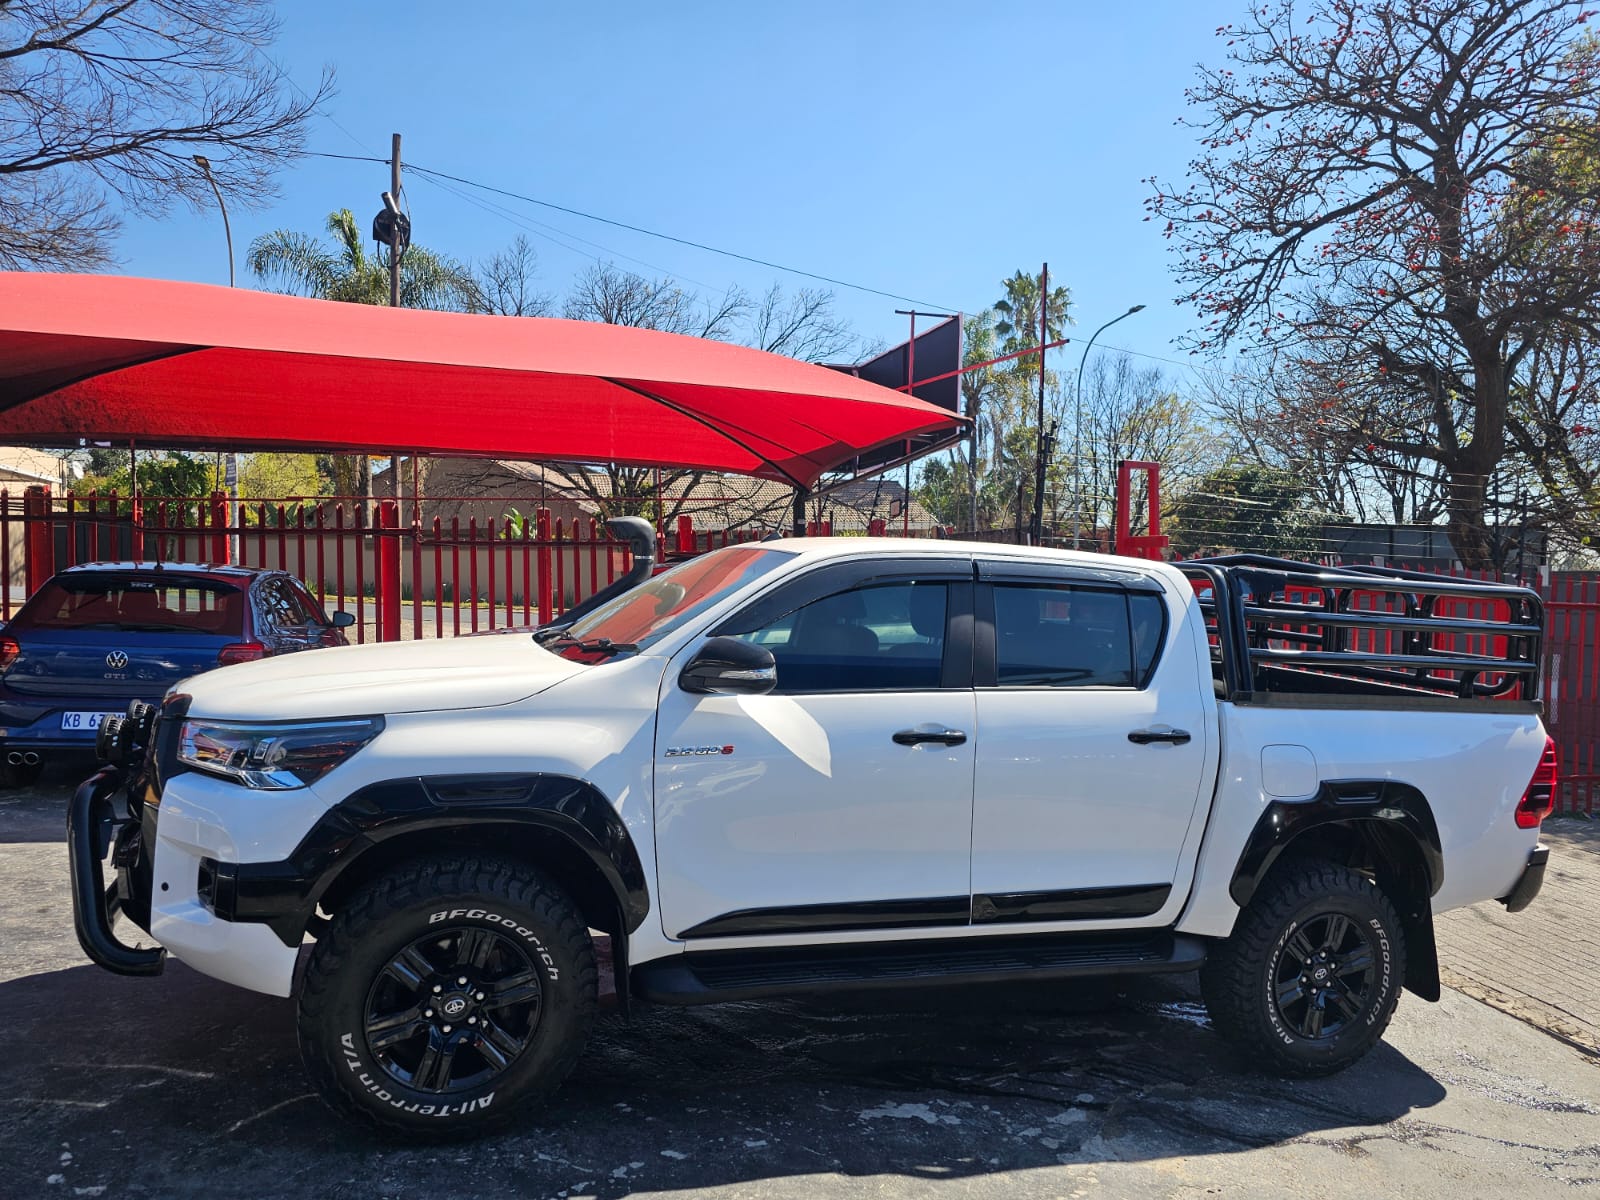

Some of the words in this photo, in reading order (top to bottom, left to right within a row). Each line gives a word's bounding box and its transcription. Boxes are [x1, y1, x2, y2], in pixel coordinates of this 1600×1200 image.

[64, 714, 80, 727] KB
[429, 909, 559, 980] BFGoodrich
[1366, 918, 1390, 1025] BFGoodrich
[1267, 950, 1294, 1044] All-Terrain
[341, 1032, 361, 1072] T/A
[359, 1073, 495, 1117] All-Terrain
